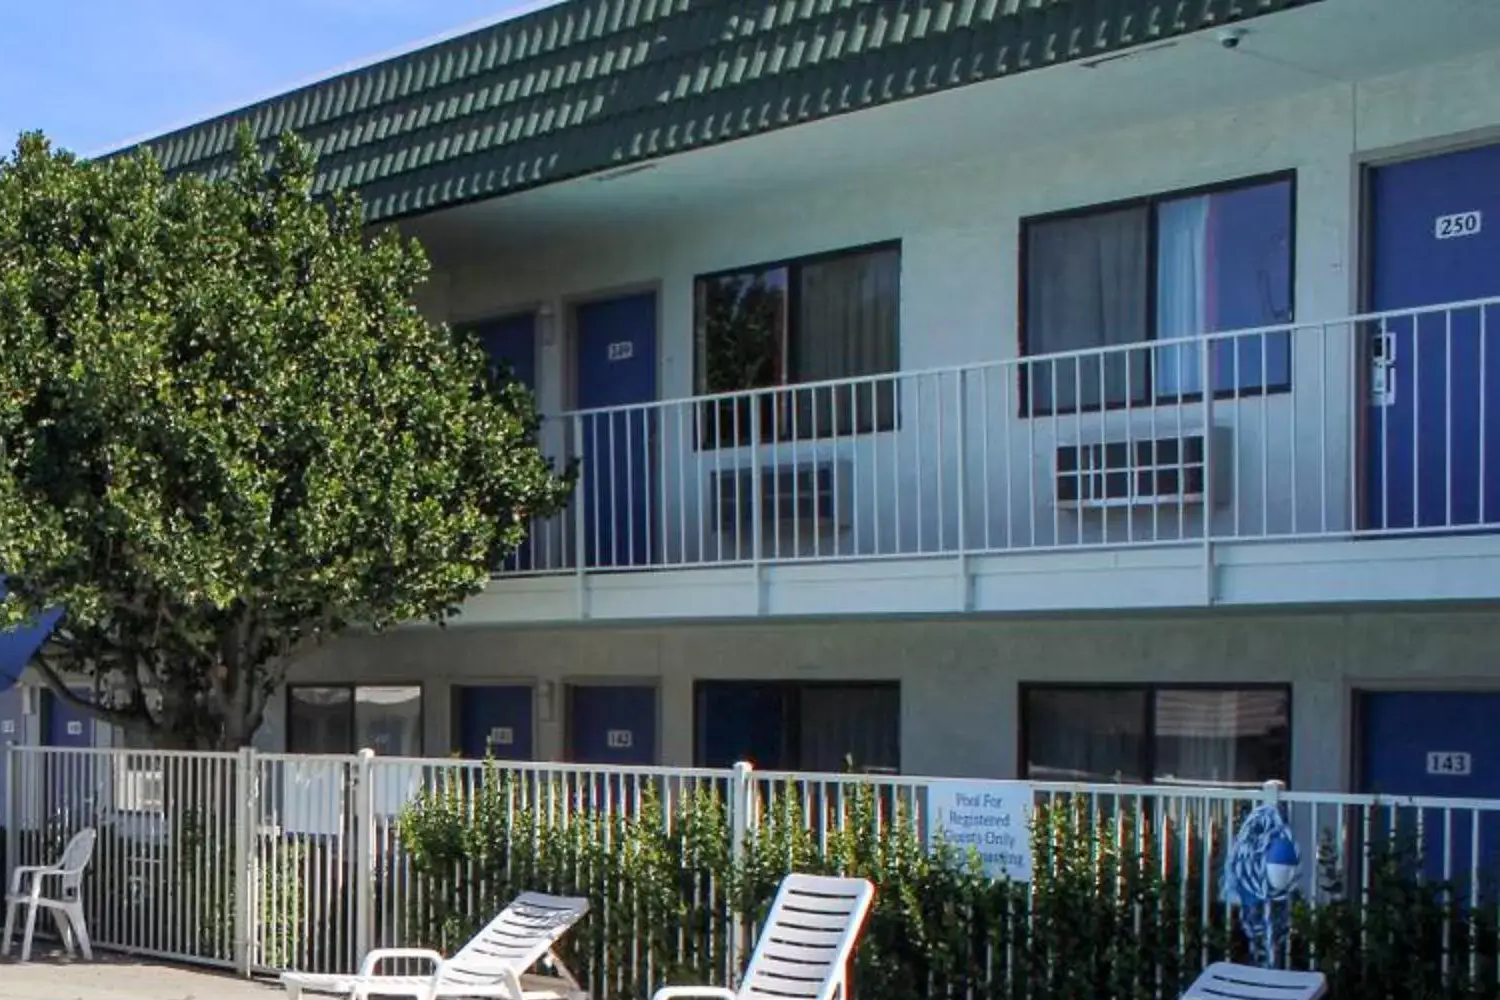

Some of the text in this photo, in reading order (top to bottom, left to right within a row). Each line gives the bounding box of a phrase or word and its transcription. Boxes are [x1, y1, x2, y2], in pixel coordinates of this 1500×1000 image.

[1441, 215, 1477, 235] 250
[1432, 755, 1466, 771] 143
[956, 793, 1002, 808] Pool For
[950, 811, 1010, 827] Registered
[985, 832, 1015, 848] Only
